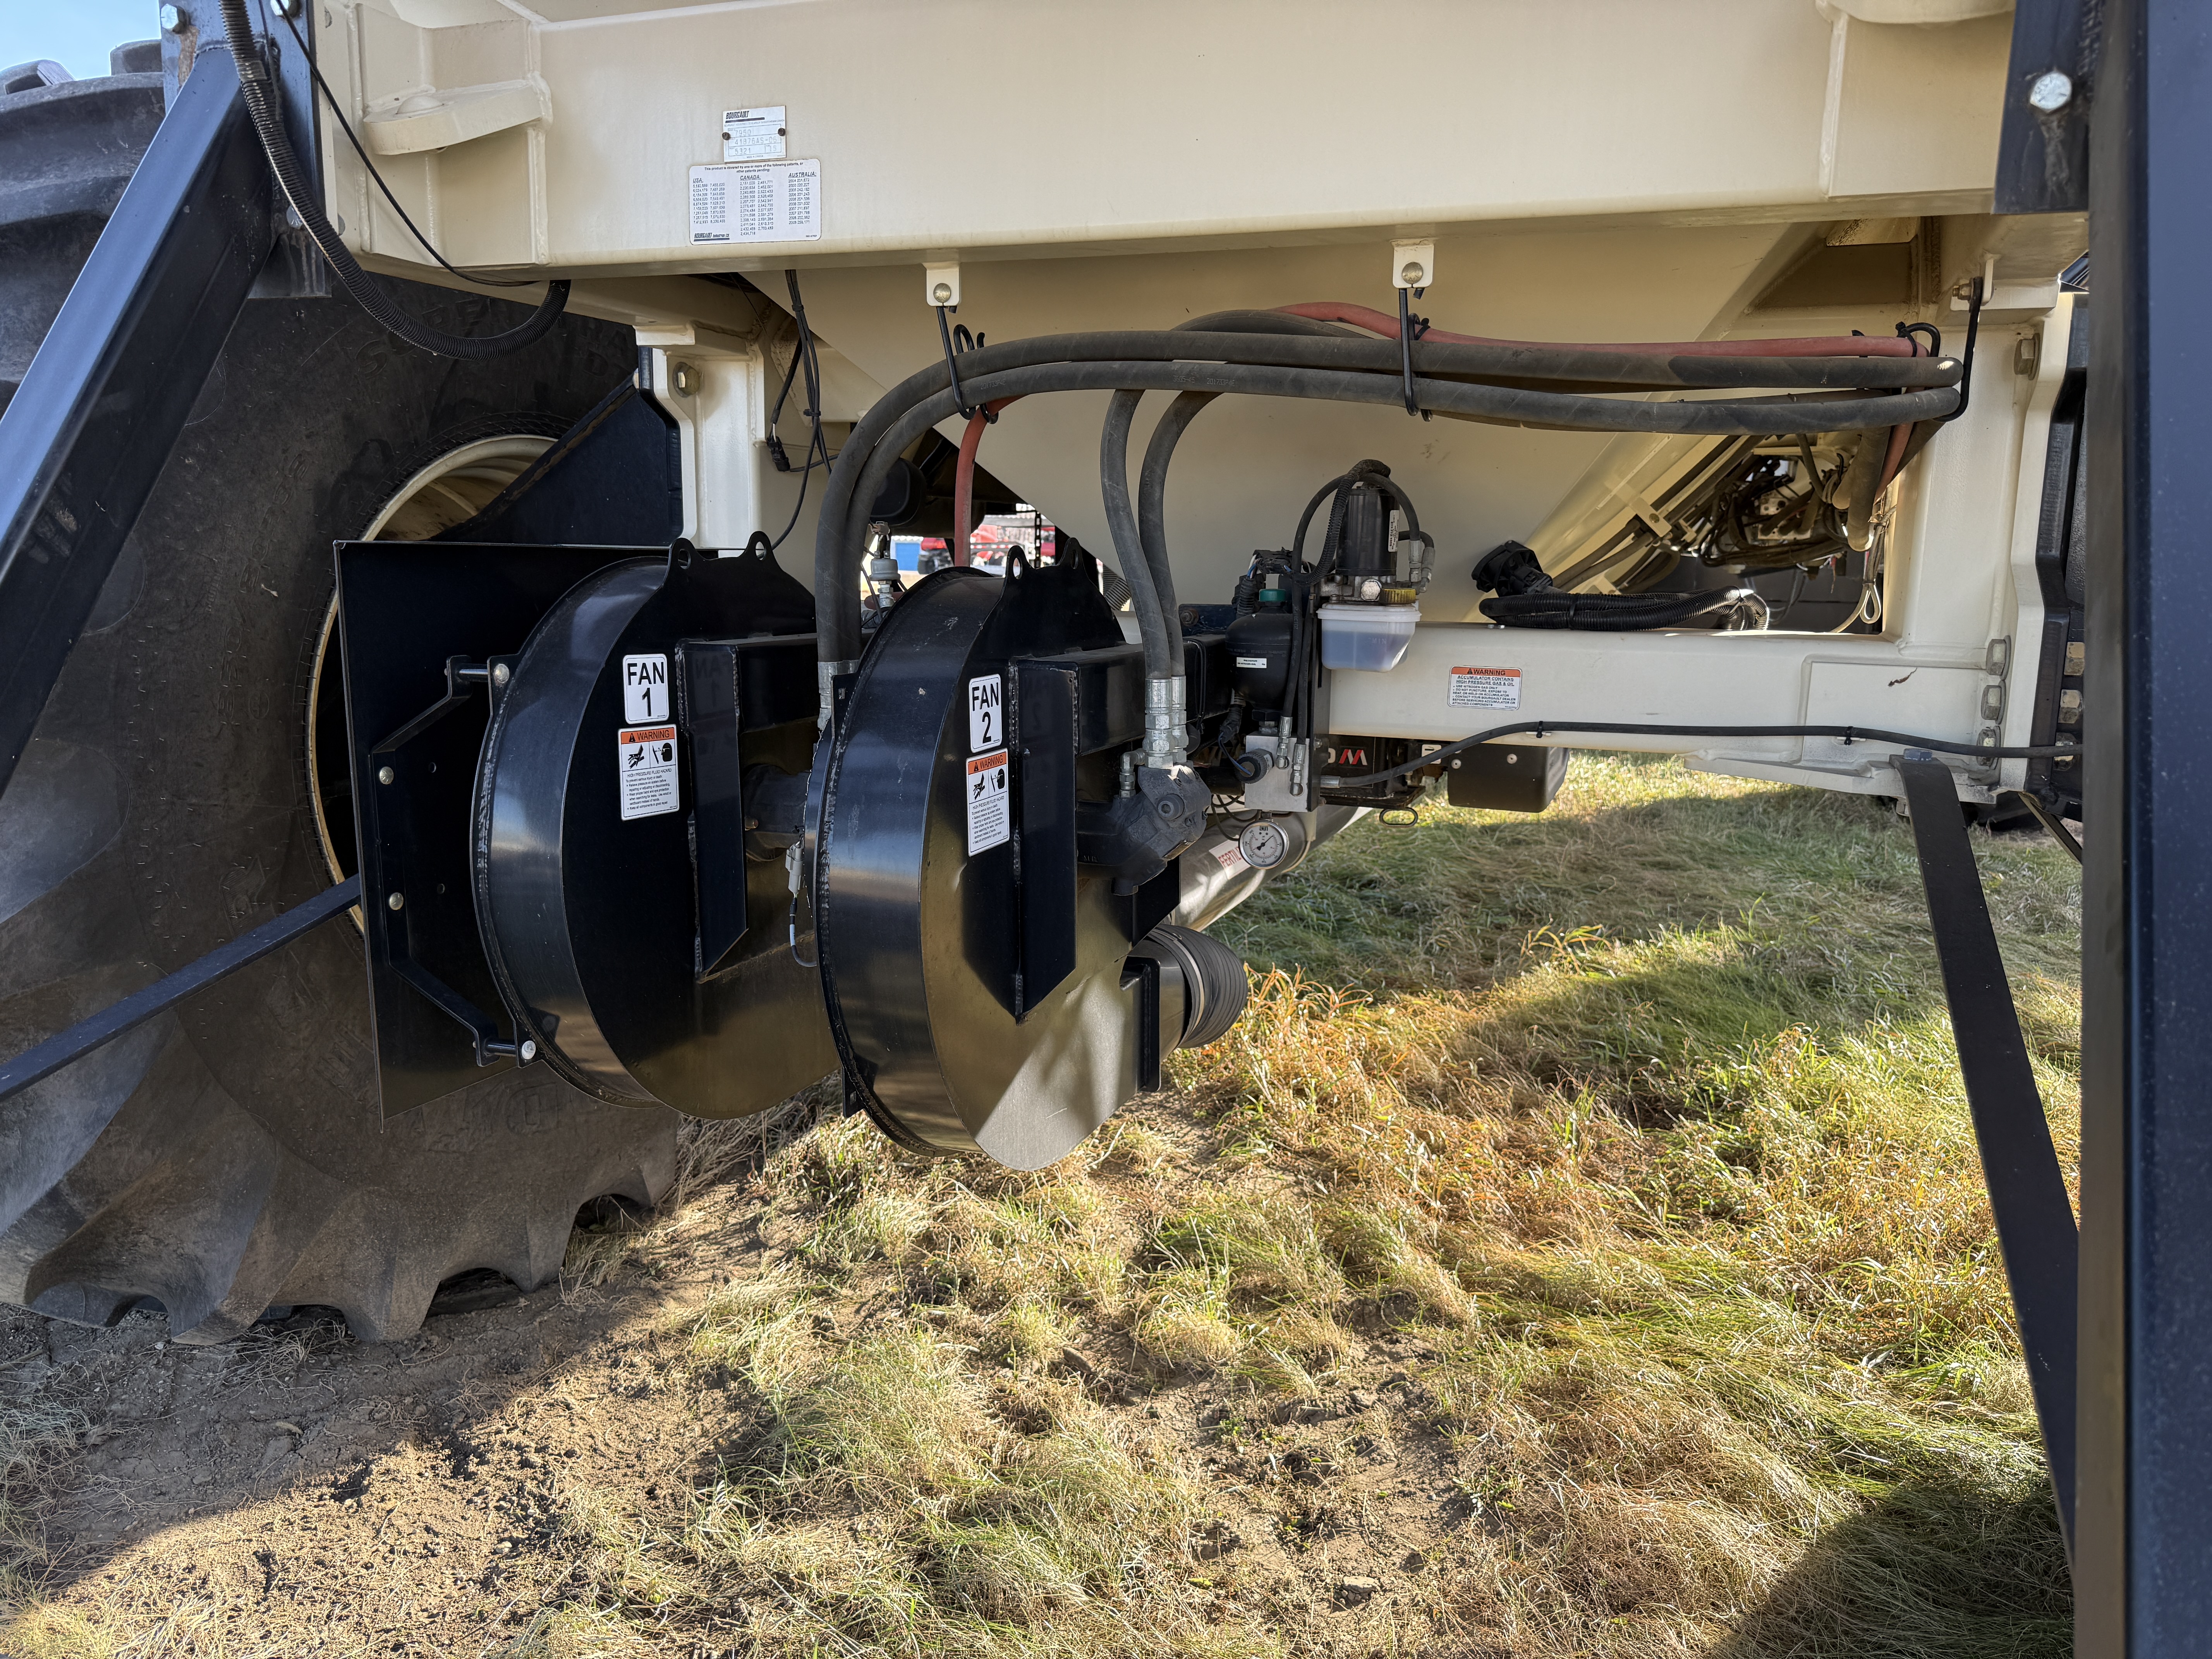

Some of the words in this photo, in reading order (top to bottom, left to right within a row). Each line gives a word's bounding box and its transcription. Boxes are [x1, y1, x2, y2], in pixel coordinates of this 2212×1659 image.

[726, 110, 749, 119] BOURGAULT
[735, 136, 776, 145] 41876AS-06
[627, 661, 665, 685] FAN
[642, 687, 652, 717] 1
[972, 682, 999, 712] FAN
[637, 730, 669, 740] WARNING
[982, 711, 991, 744] 2
[980, 754, 1003, 769] WARNING
